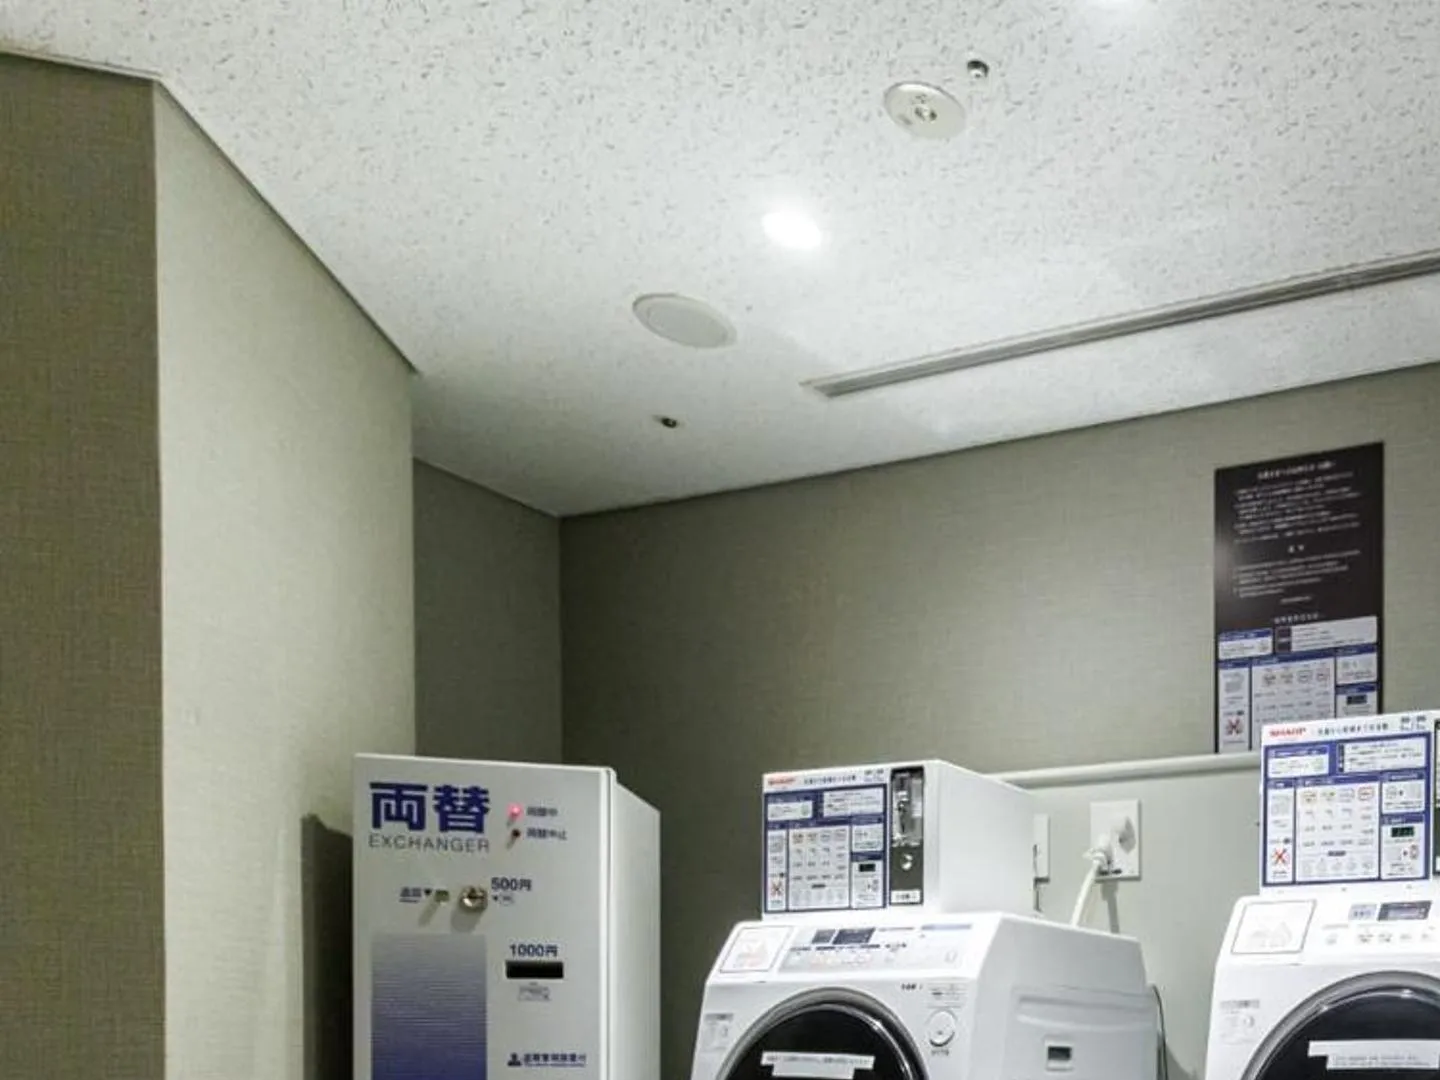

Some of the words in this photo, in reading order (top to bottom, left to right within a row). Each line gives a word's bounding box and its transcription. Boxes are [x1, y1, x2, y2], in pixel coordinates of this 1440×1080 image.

[369, 782, 490, 833] 両替
[368, 833, 490, 853] EXCHANGER
[491, 877, 532, 891] 500円
[509, 944, 558, 957] 1000円
